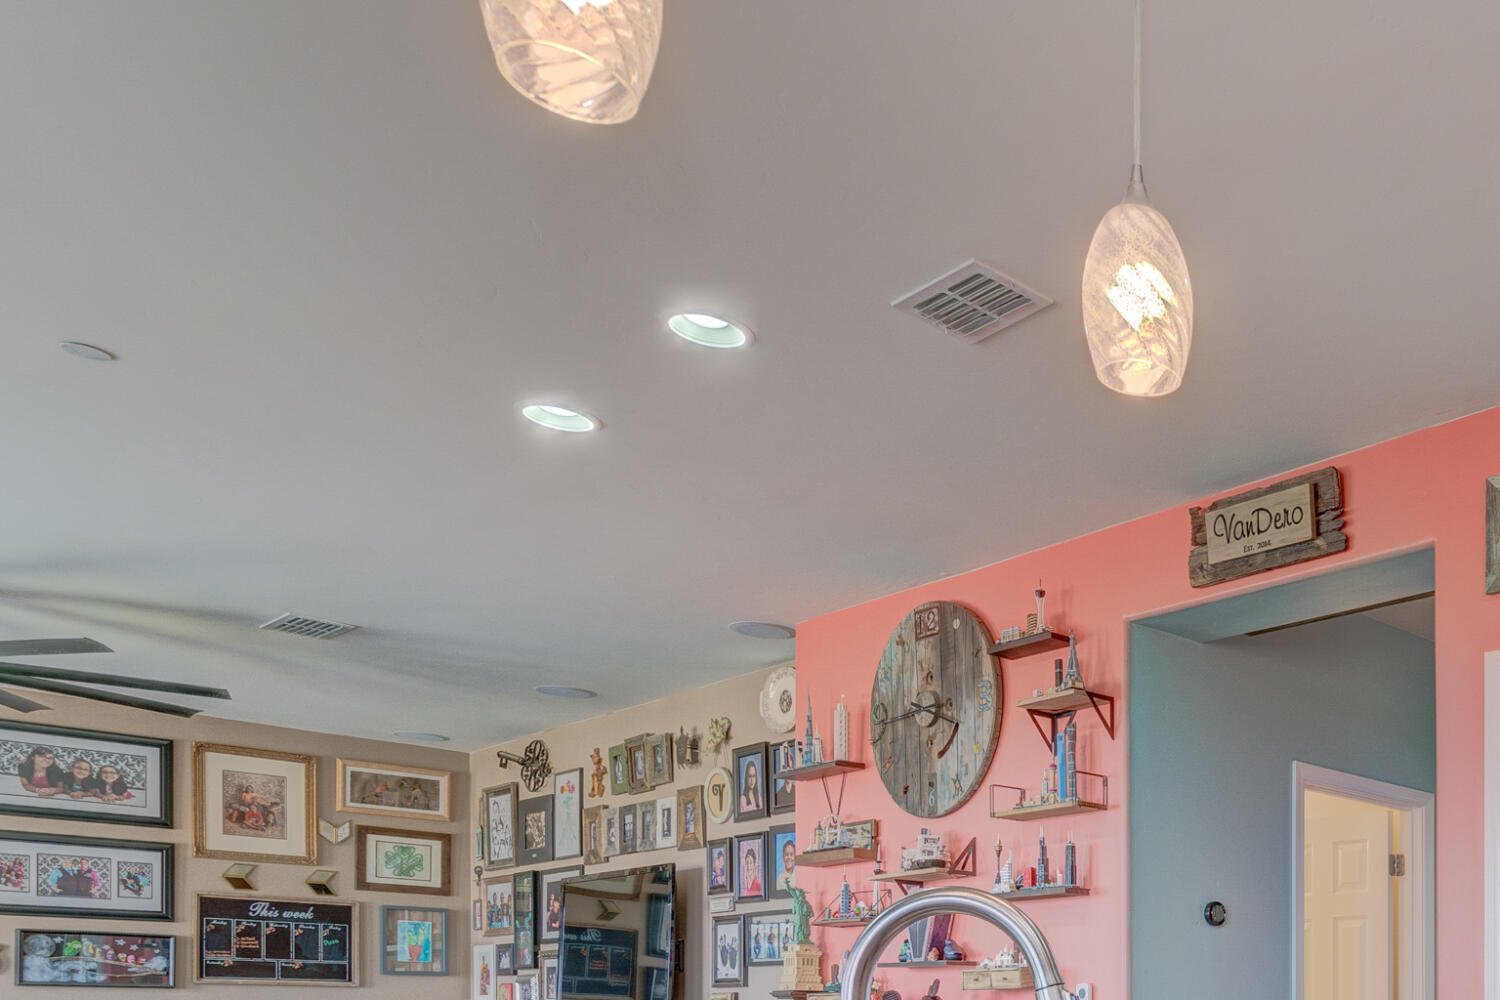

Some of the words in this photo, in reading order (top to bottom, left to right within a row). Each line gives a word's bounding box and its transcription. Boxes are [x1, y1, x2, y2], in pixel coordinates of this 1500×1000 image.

[1213, 506, 1304, 544] VanDero
[916, 610, 937, 635] 12
[977, 680, 992, 711] 3
[249, 902, 280, 917] This
[282, 906, 314, 919] week
